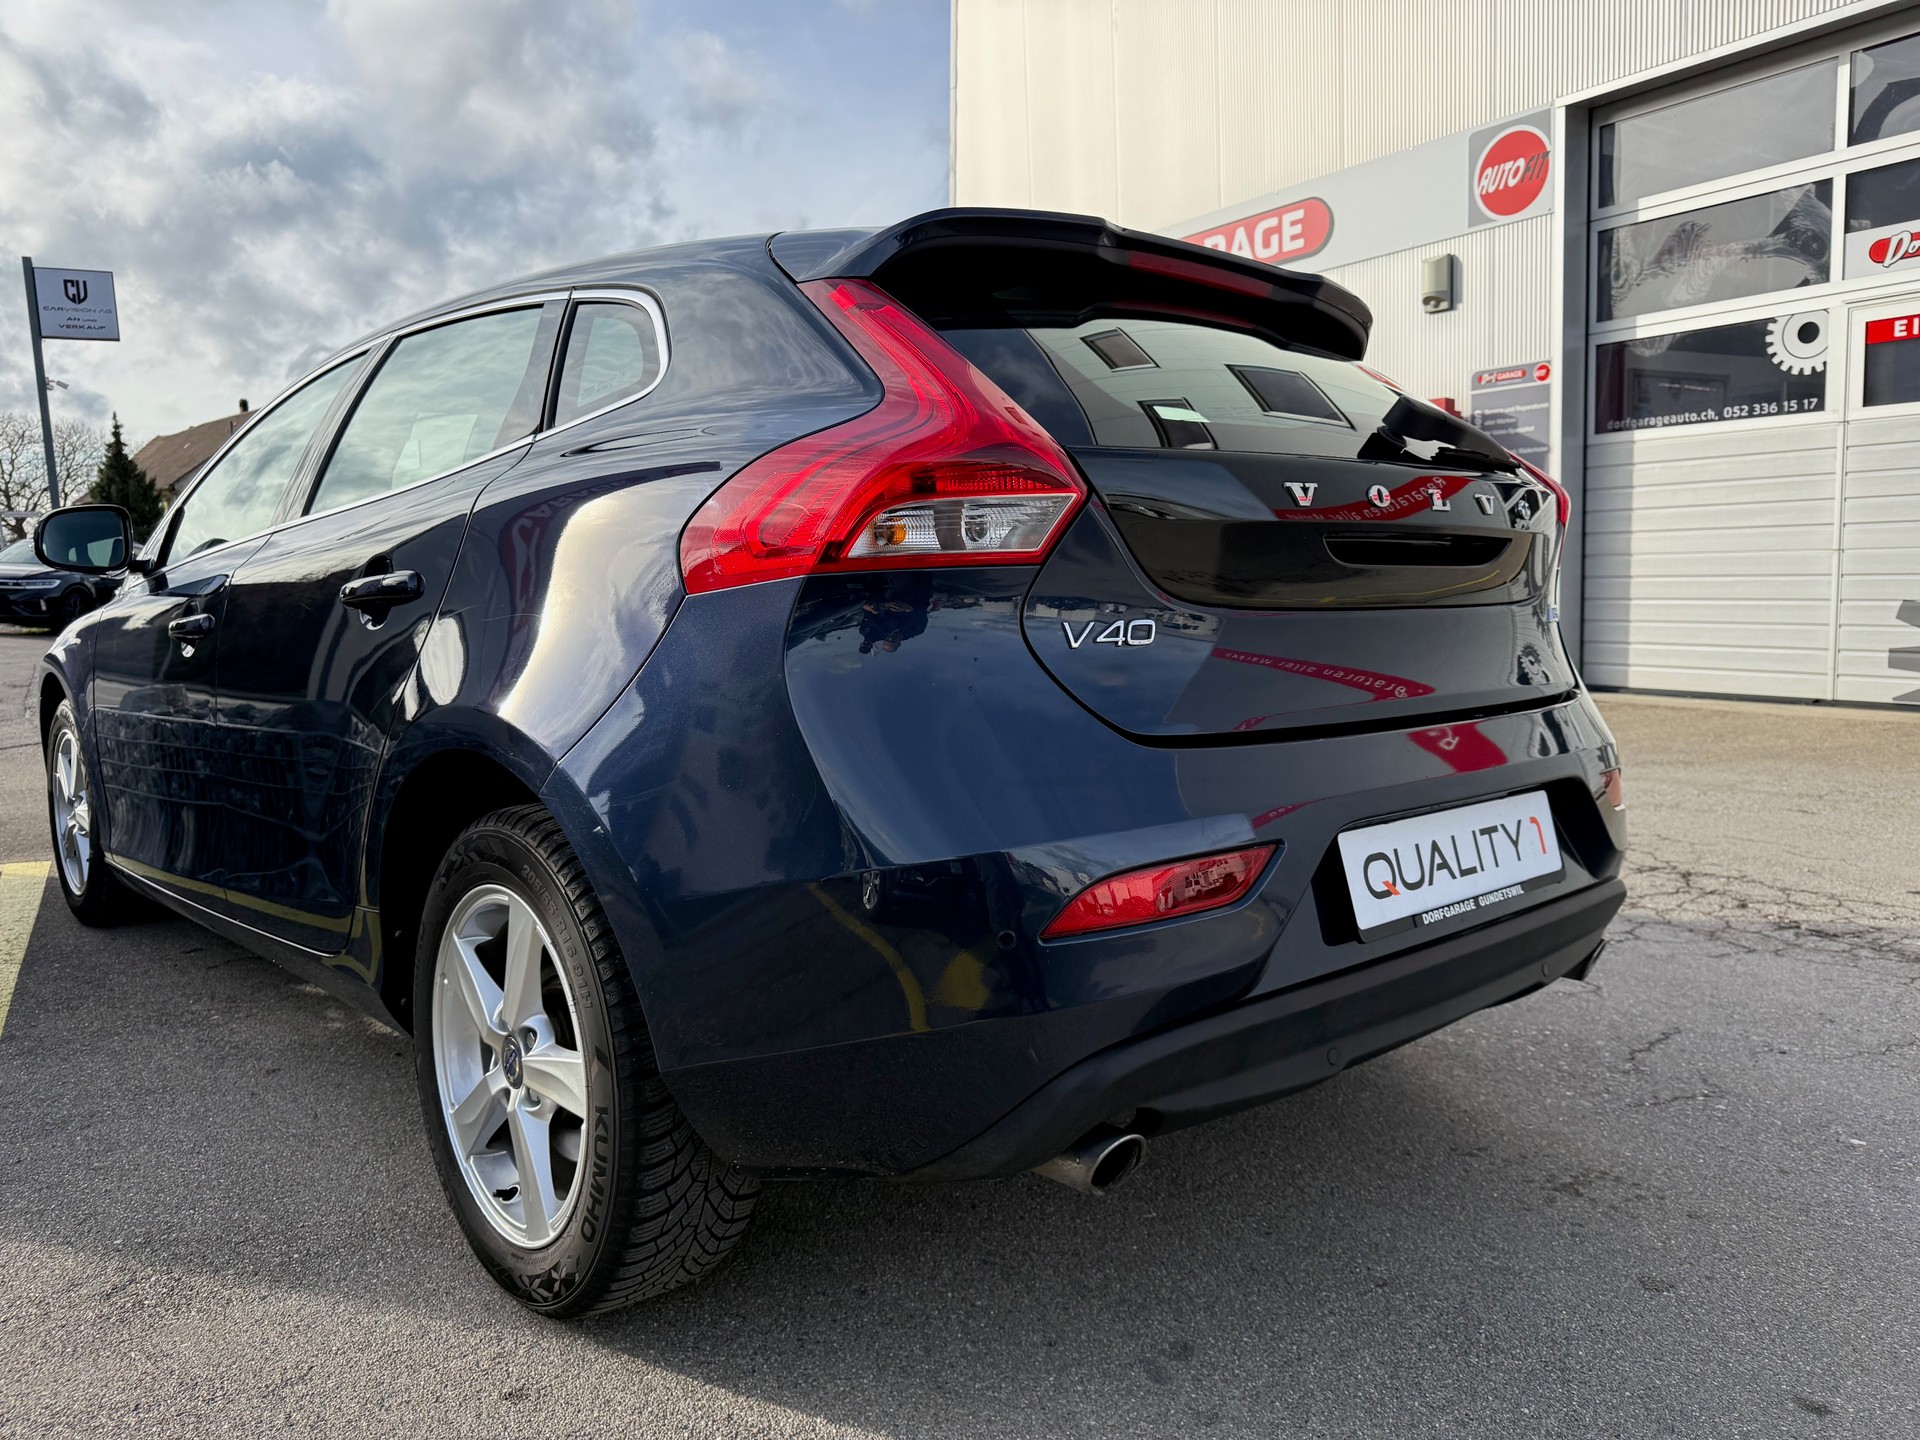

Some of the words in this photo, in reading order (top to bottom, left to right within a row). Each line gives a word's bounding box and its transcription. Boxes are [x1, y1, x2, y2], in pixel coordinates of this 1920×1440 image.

[1480, 150, 1551, 196] AUTOFIT
[1723, 405, 1749, 418] 052
[1752, 402, 1779, 416] 336
[1783, 400, 1798, 412] 15
[1803, 397, 1819, 410] 17
[1062, 619, 1156, 649] V40
[1362, 819, 1522, 900] QUALITY
[1421, 898, 1477, 925] DORFGARAGE
[1478, 884, 1525, 907] GUNDETSWIL
[580, 1105, 609, 1244] KUMHO
